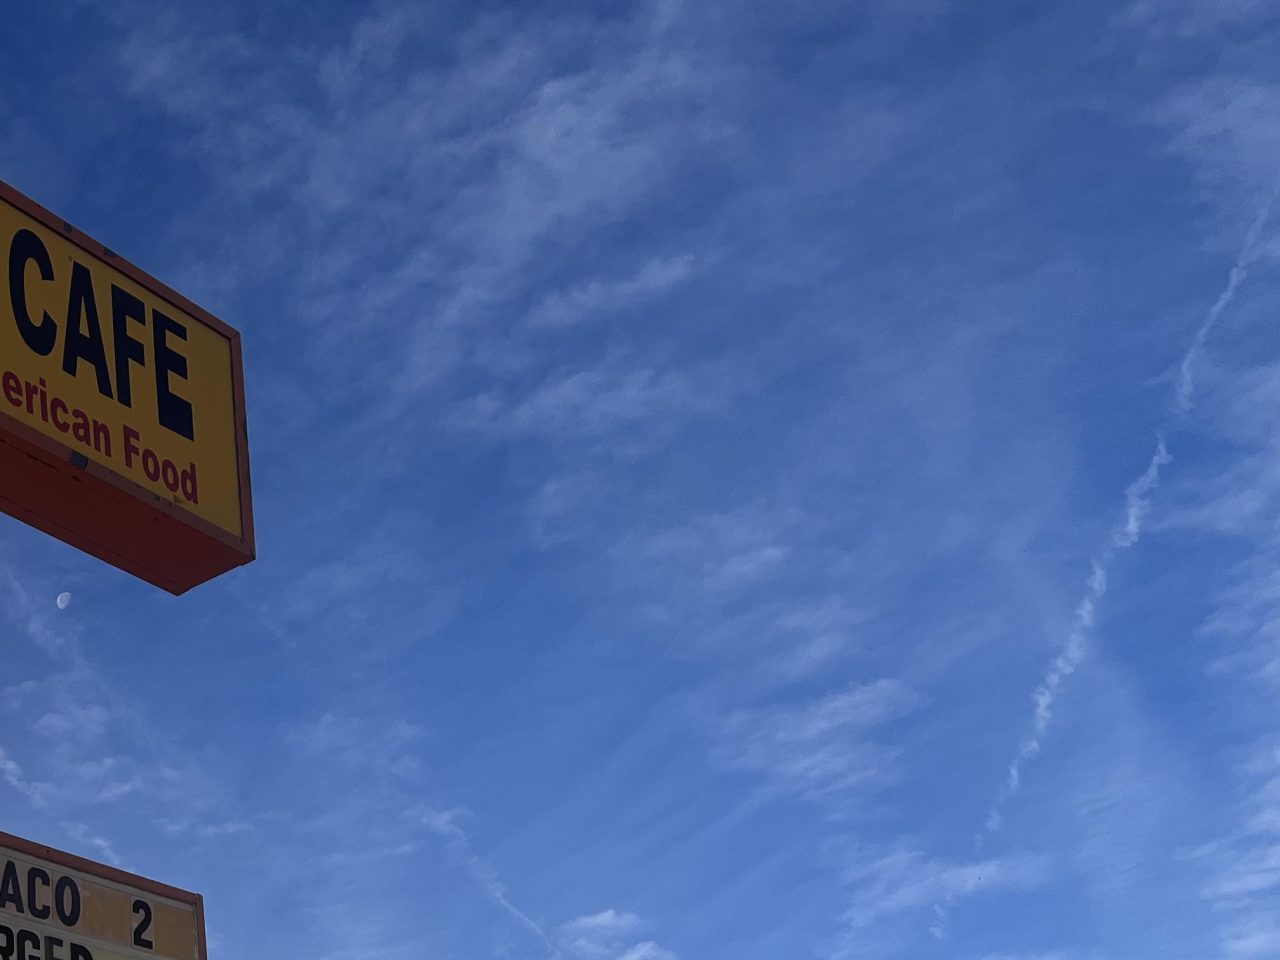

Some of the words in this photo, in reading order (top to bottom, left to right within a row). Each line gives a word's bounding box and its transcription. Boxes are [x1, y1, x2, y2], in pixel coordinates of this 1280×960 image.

[8, 229, 195, 442] CAFE
[124, 424, 199, 505] Food
[132, 900, 154, 949] 2
